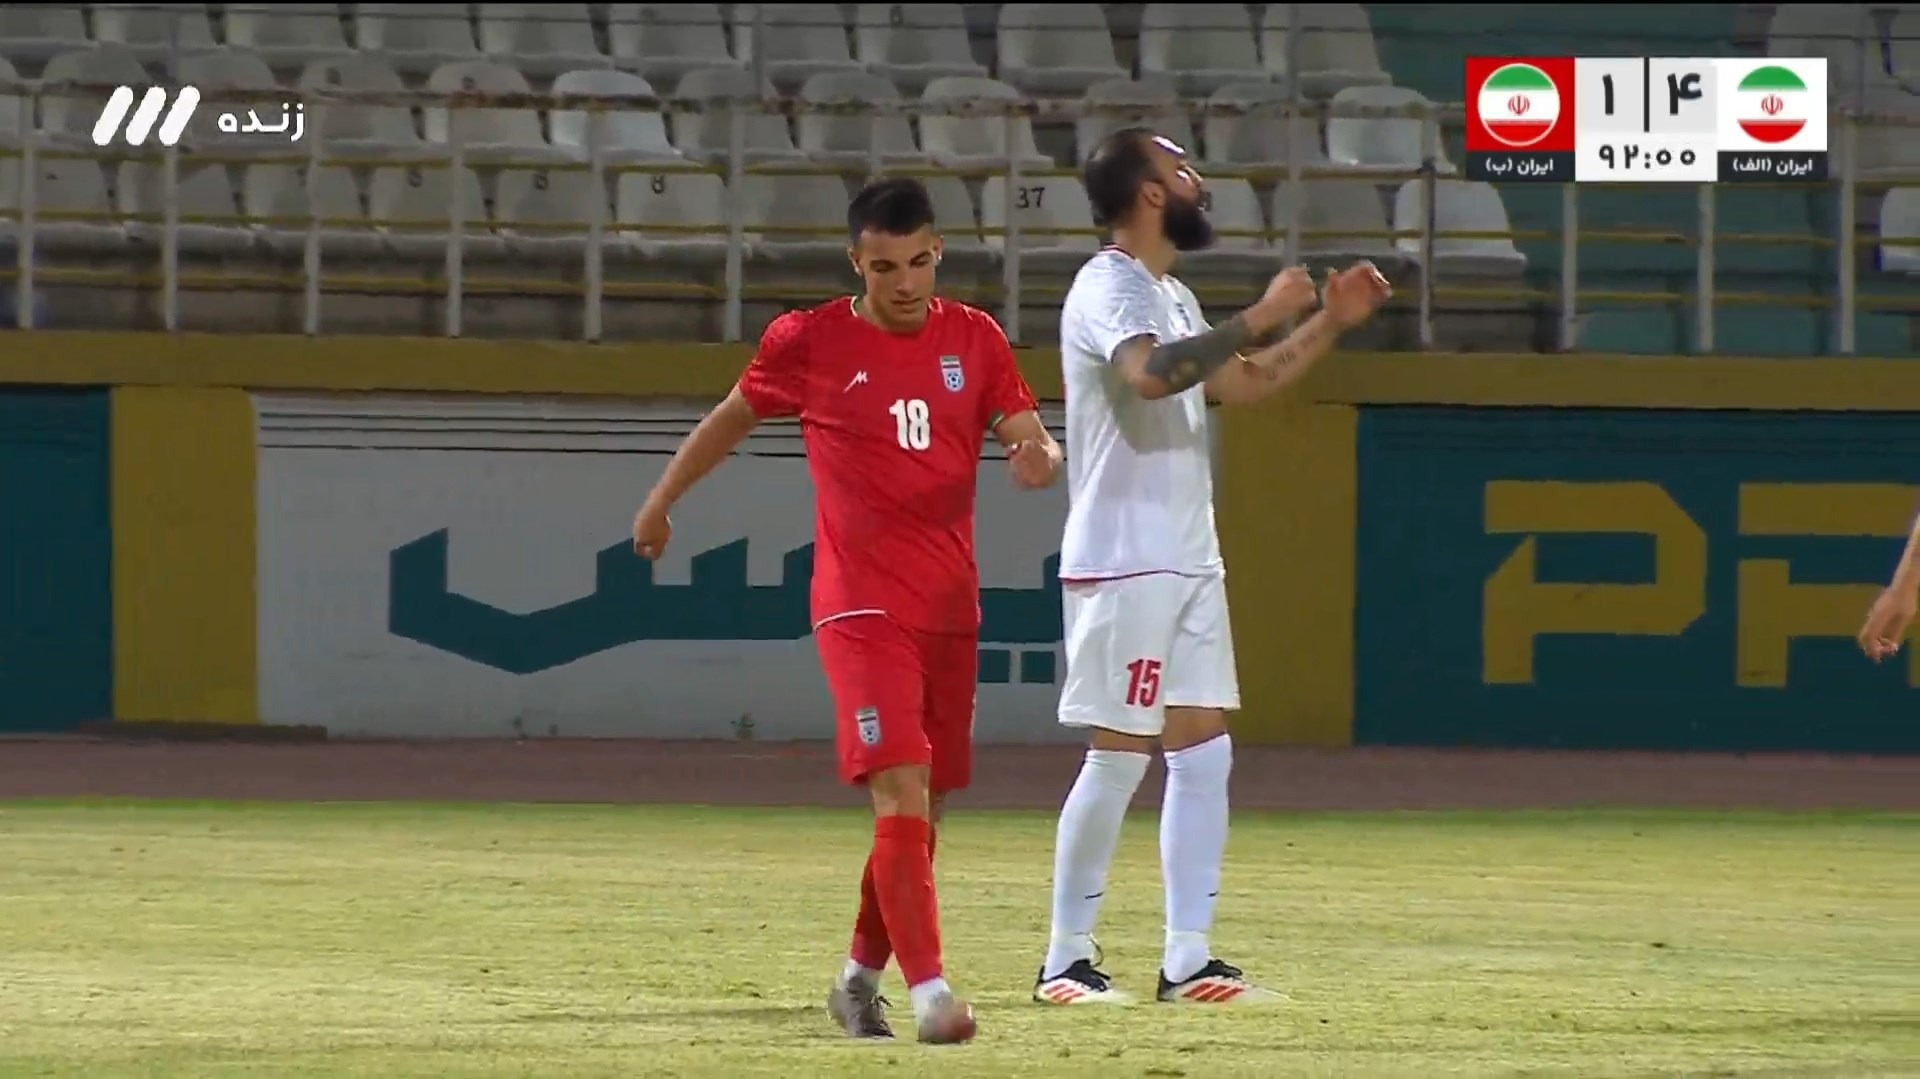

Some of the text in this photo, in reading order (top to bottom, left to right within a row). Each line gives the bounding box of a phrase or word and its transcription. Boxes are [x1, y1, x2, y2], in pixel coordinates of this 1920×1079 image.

[1016, 186, 1046, 208] 37
[889, 399, 931, 450] 18
[1125, 658, 1162, 707] 15
